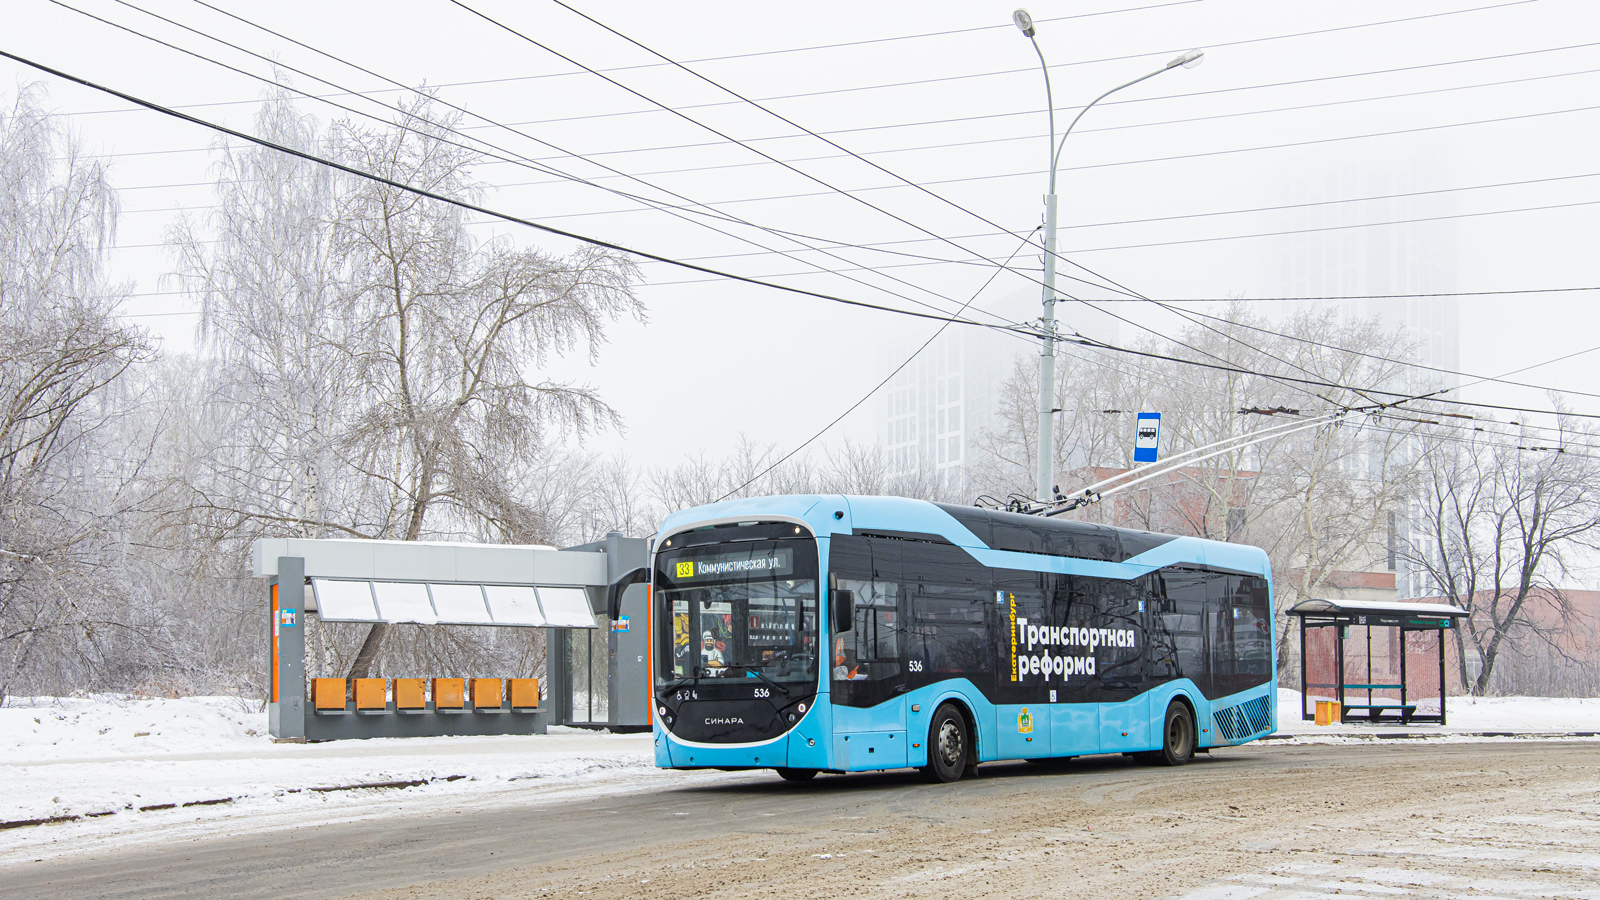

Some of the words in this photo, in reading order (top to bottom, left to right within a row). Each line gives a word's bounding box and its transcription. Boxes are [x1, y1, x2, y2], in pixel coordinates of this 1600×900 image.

[679, 563, 691, 575] 33
[698, 559, 766, 575] Коммунистическая
[768, 557, 781, 569] ул.
[1009, 592, 1018, 682] Екатеринбург
[1016, 617, 1135, 653] Транспортная
[908, 660, 923, 672] 536
[1018, 649, 1096, 682] реформа
[754, 688, 770, 698] 536
[704, 717, 744, 725] СИНАРА
